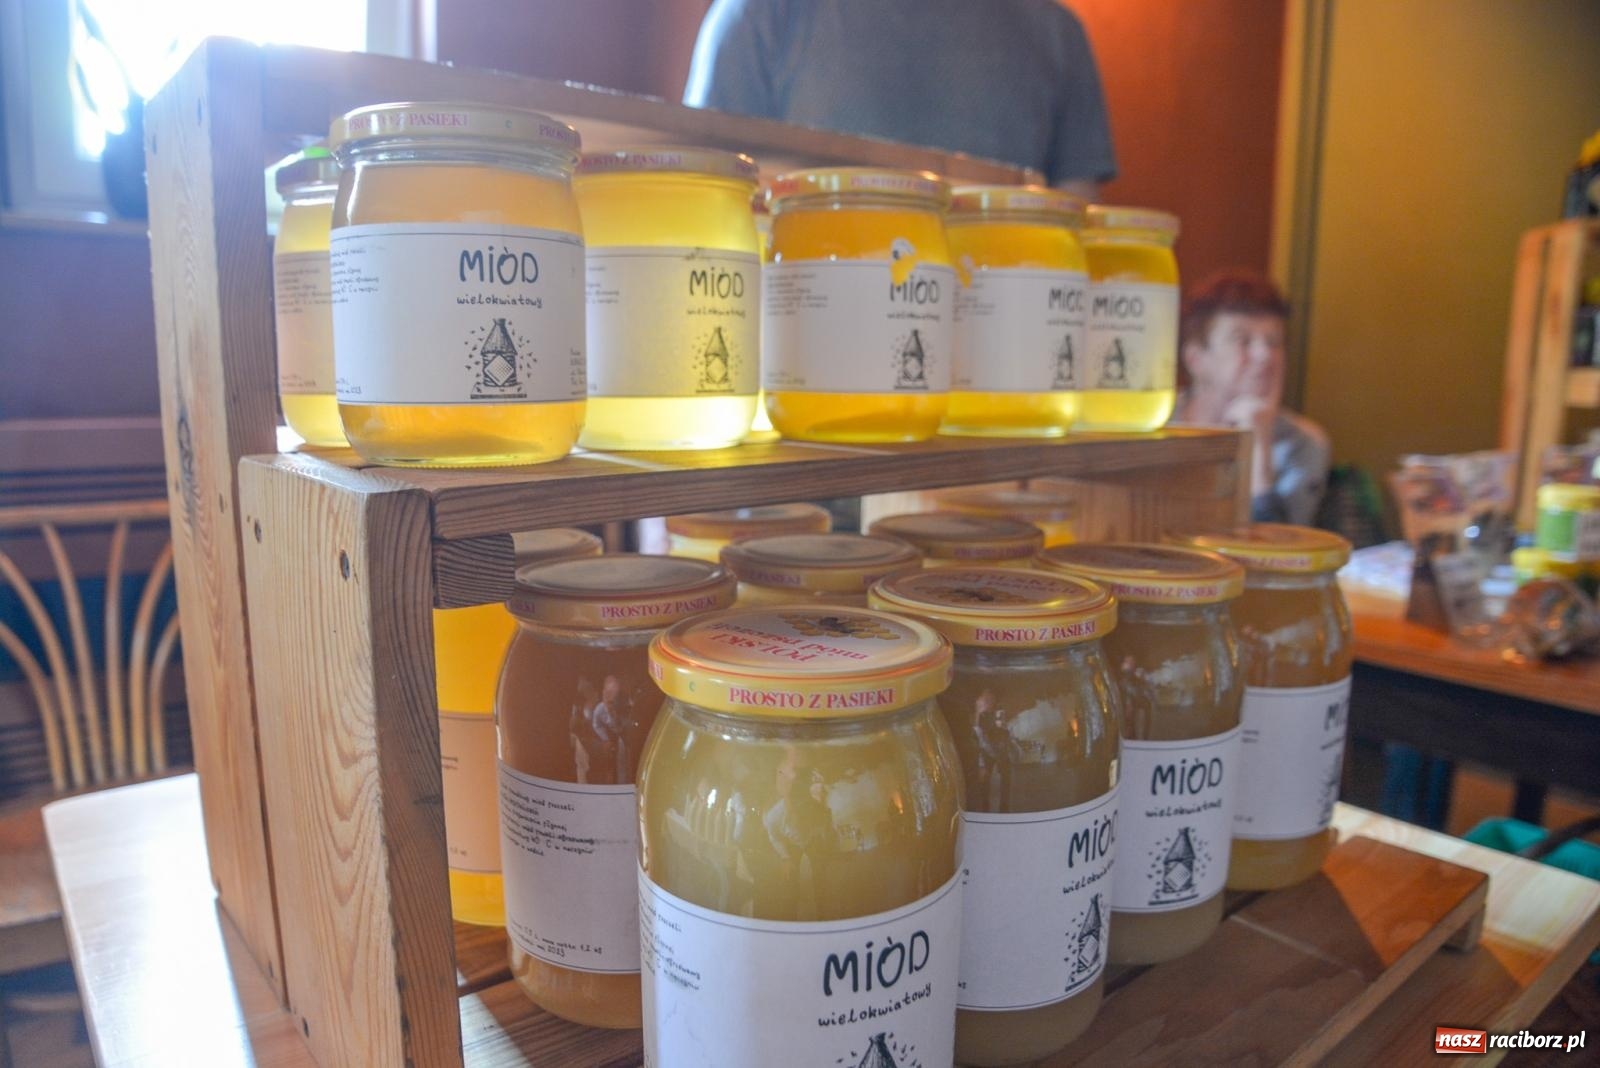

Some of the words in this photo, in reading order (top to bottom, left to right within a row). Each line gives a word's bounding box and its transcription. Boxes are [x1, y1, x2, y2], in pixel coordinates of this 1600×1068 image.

[409, 112, 469, 128] PASIEKI
[456, 293, 543, 309] wielokwiatowy
[601, 604, 660, 619] PROSTO
[662, 605, 672, 615] Z
[975, 627, 1036, 642] PROSTO
[1038, 627, 1049, 641] Z
[1051, 620, 1097, 640] PASIEKI
[729, 687, 805, 709] PROSTO
[808, 693, 822, 710] Z
[826, 687, 895, 710] PASIEKI
[818, 982, 931, 1027] wielokwiatowy
